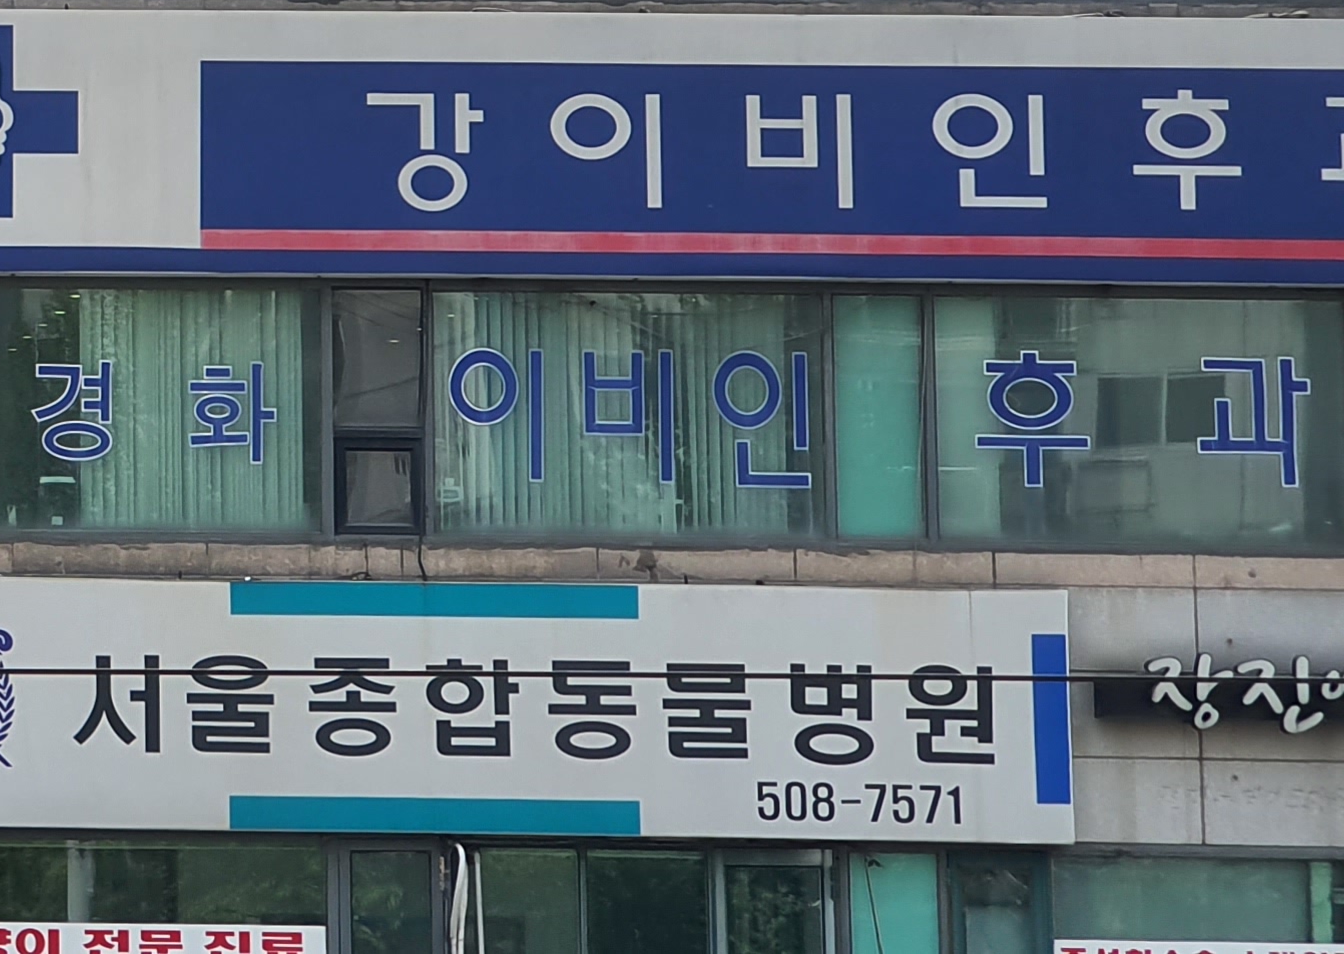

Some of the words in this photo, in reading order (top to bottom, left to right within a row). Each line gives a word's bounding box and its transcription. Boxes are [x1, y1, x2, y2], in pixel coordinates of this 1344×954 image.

[365, 89, 1344, 213] 강이비인후
[73, 653, 997, 766] 서울종합동물병원
[755, 781, 963, 825] 508-7571
